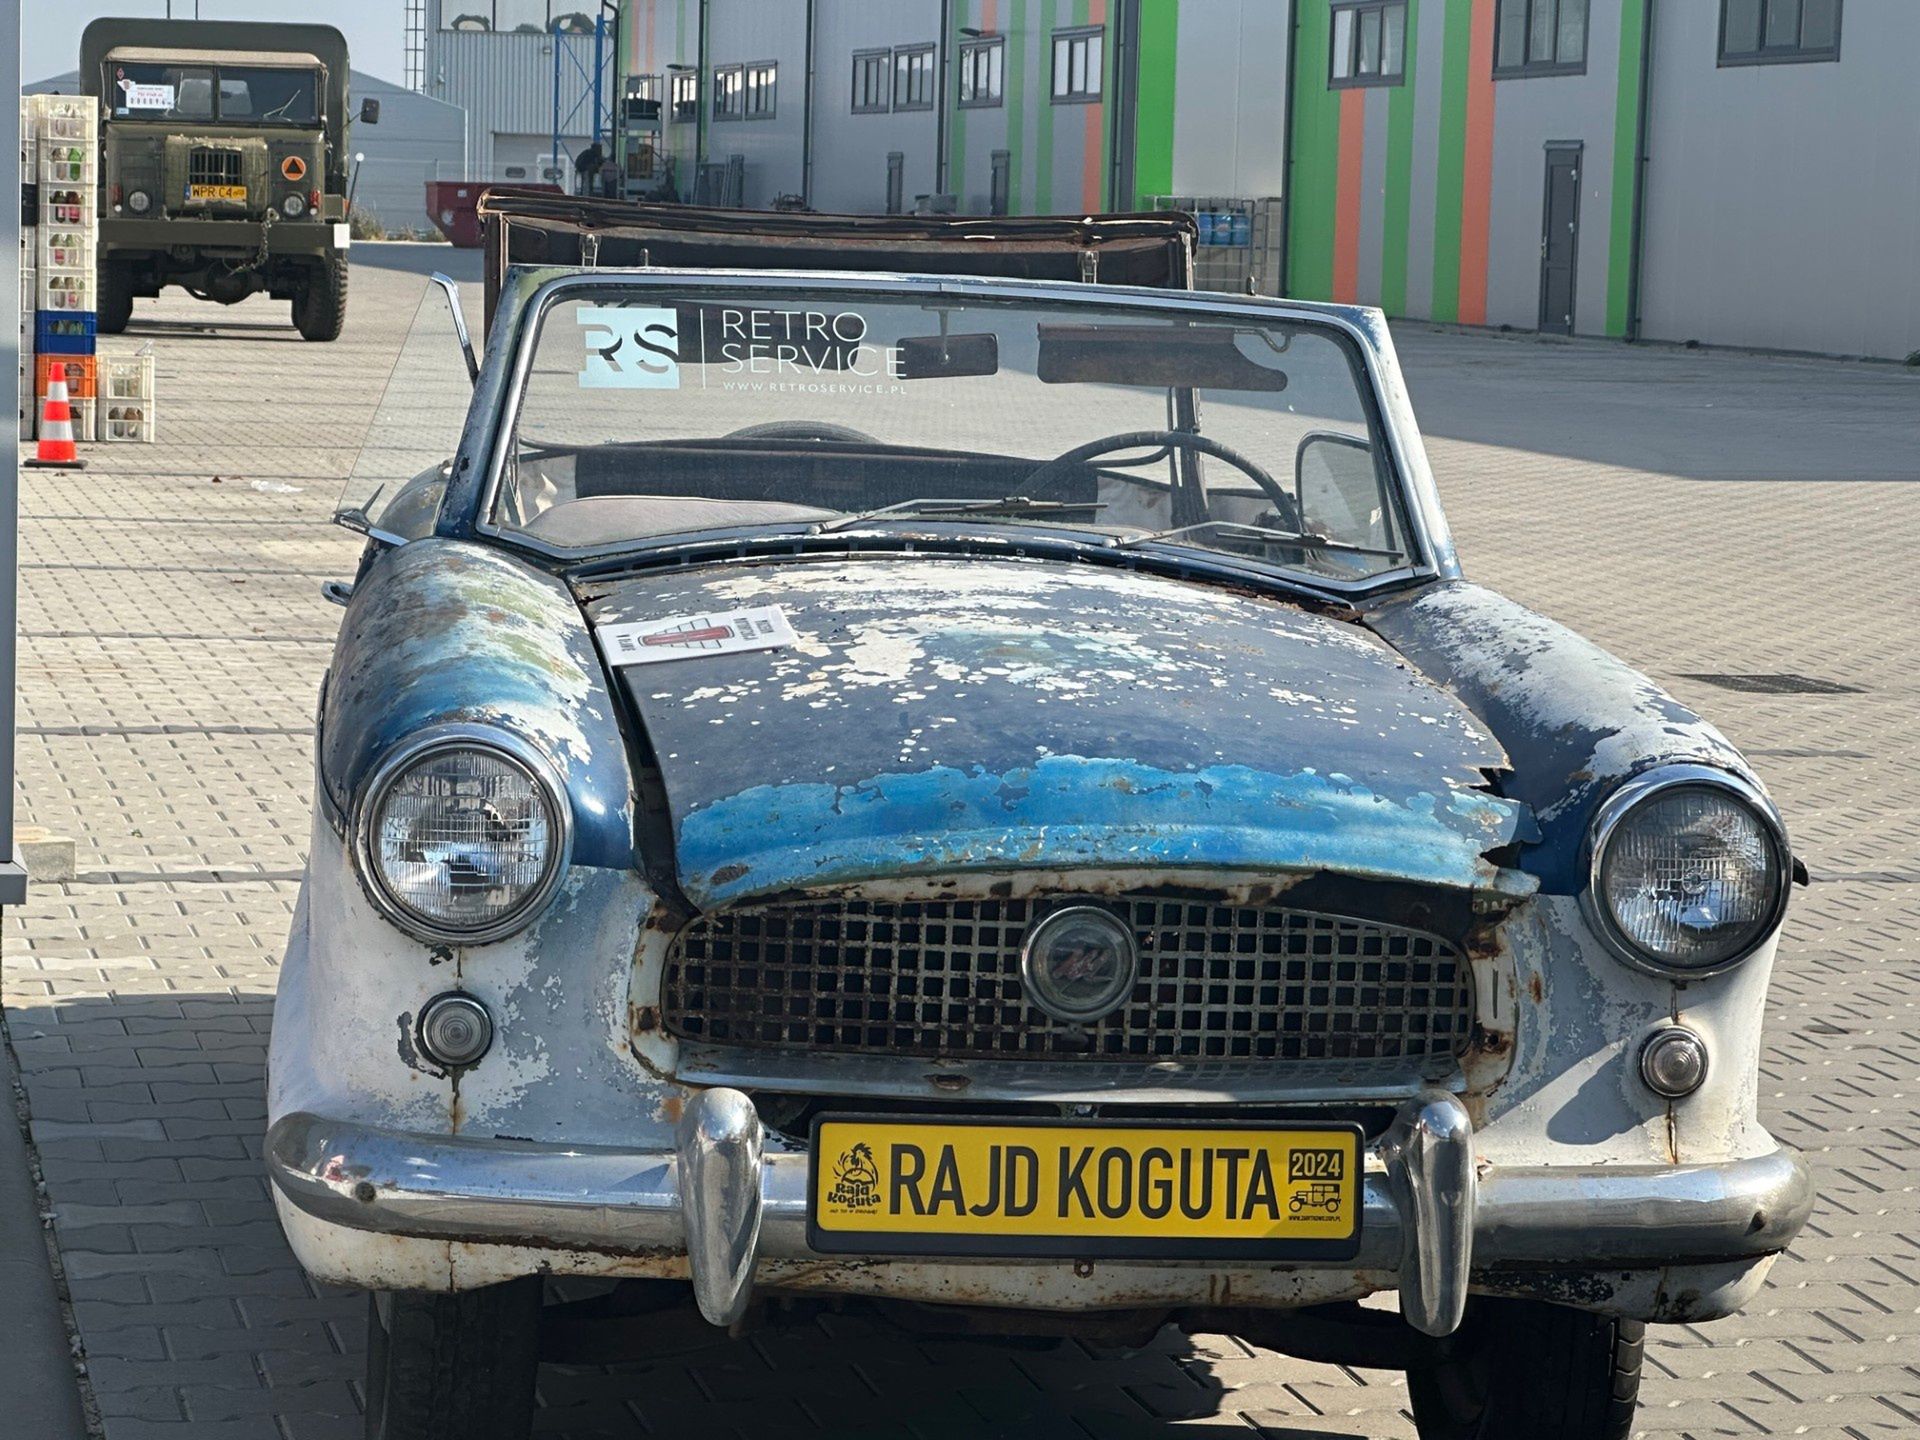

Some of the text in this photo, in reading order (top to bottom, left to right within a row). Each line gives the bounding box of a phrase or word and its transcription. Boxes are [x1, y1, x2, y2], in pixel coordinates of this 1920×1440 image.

[192, 185, 216, 198] WPR
[721, 309, 868, 342] RETRO
[577, 322, 679, 374] RS
[721, 343, 908, 377] SERVICE
[1291, 1152, 1341, 1177] 2024
[835, 1183, 870, 1197] Rajd
[889, 1143, 1281, 1220] RAJD KOGUTA
